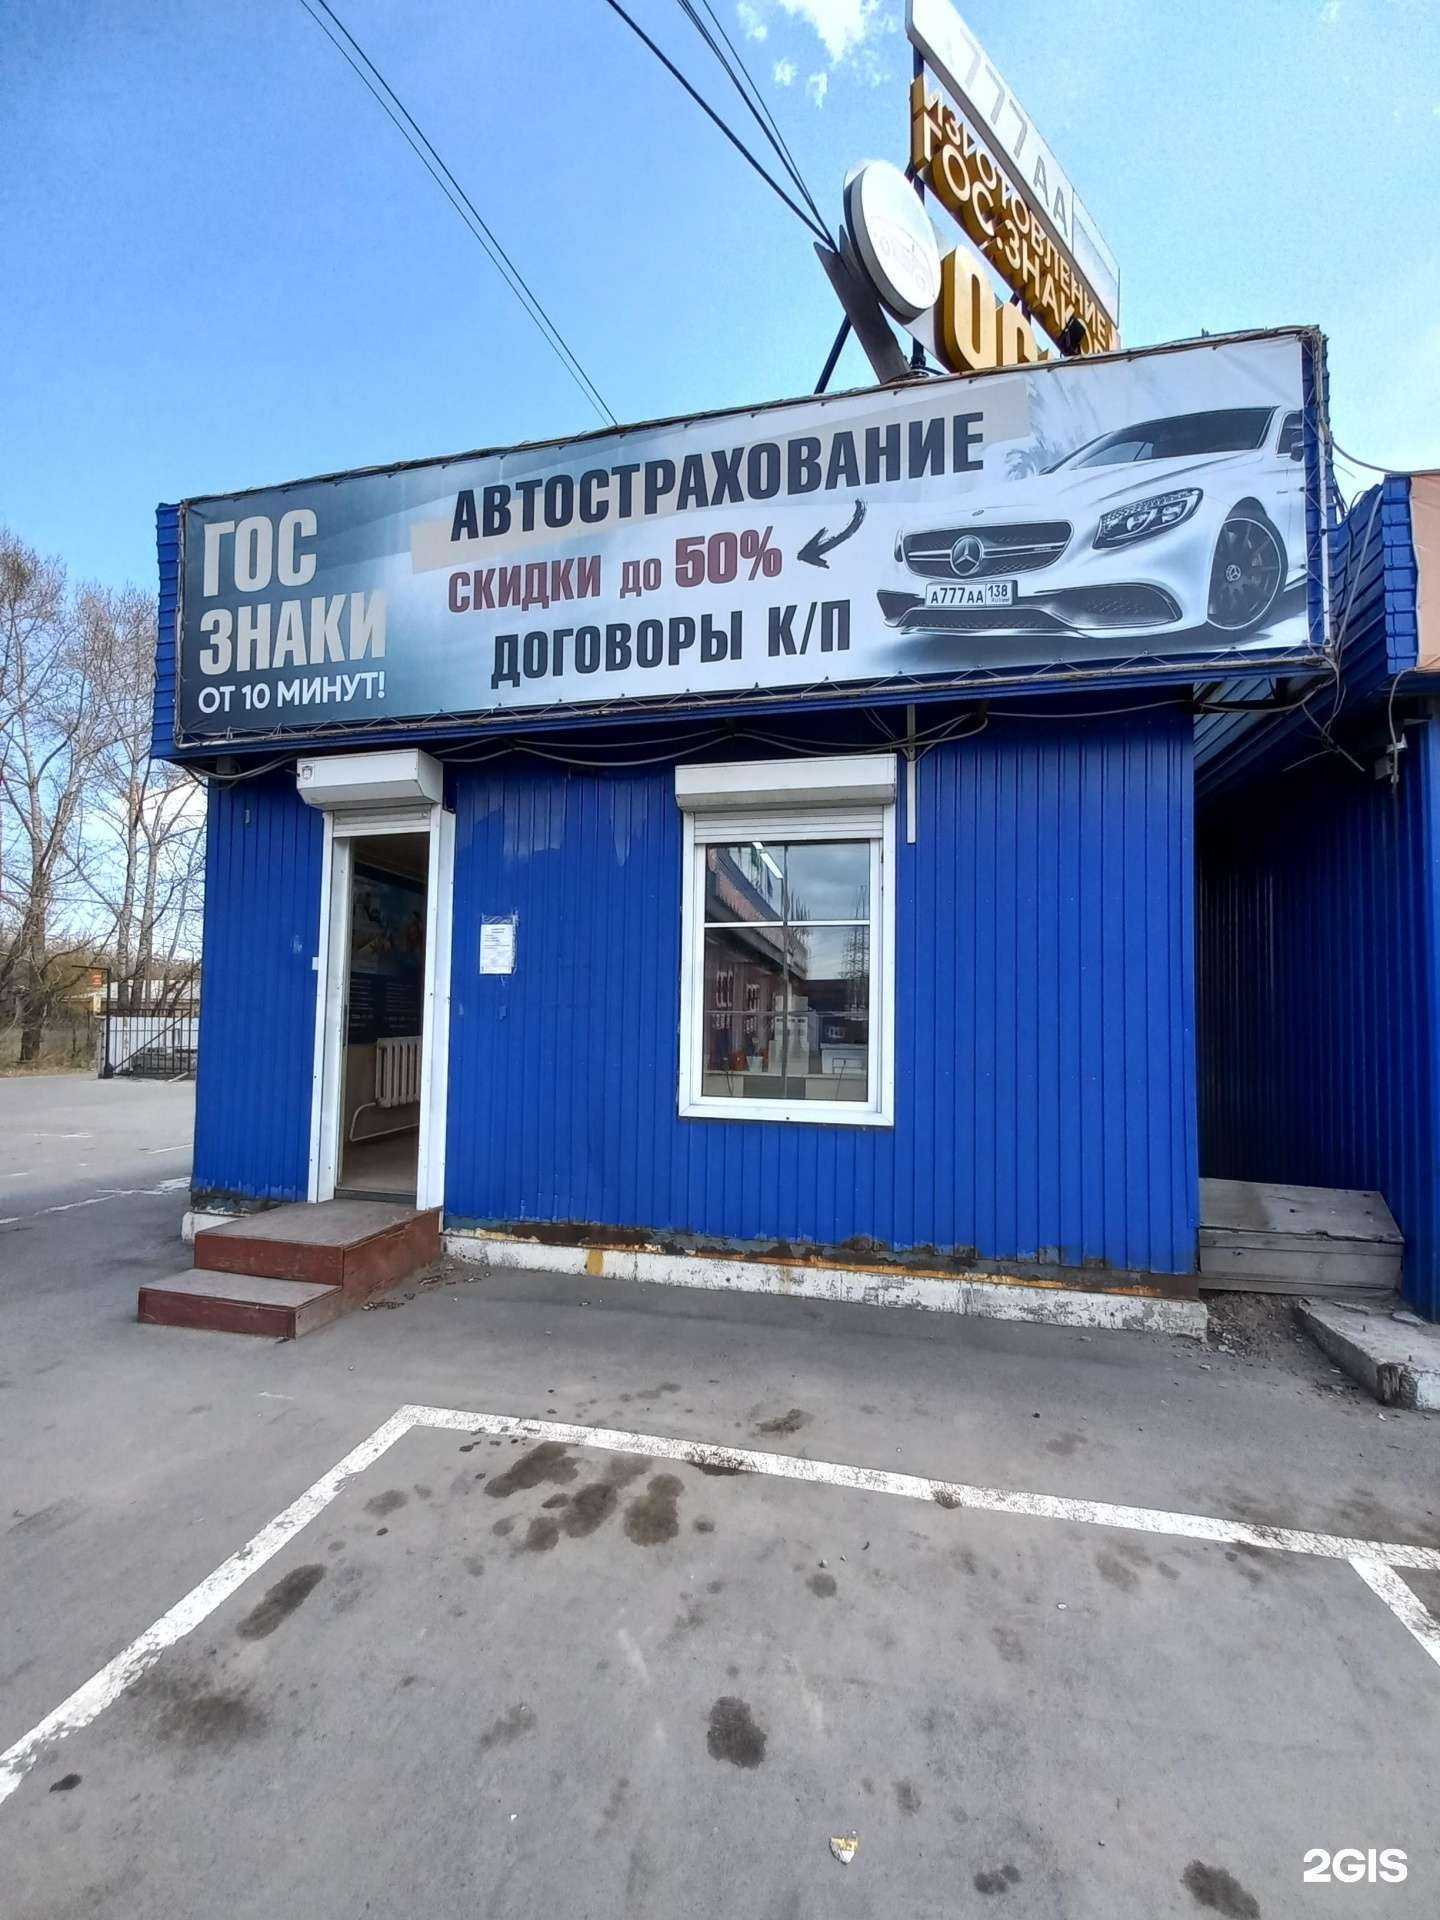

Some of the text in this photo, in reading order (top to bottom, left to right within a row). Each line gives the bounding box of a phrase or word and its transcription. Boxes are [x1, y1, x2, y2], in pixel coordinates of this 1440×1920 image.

[451, 411, 985, 542] АВТОСТРАХОВАНИЕ
[202, 508, 318, 598] ГОС
[448, 554, 601, 614] СКИДКИ
[674, 525, 783, 588] 50%
[987, 584, 1008, 598] 138
[199, 588, 387, 676] ЗНАКИ
[490, 599, 852, 690] ДОГОВОРЫ К/П
[198, 670, 386, 714] ОТ 10 МИНУТ!
